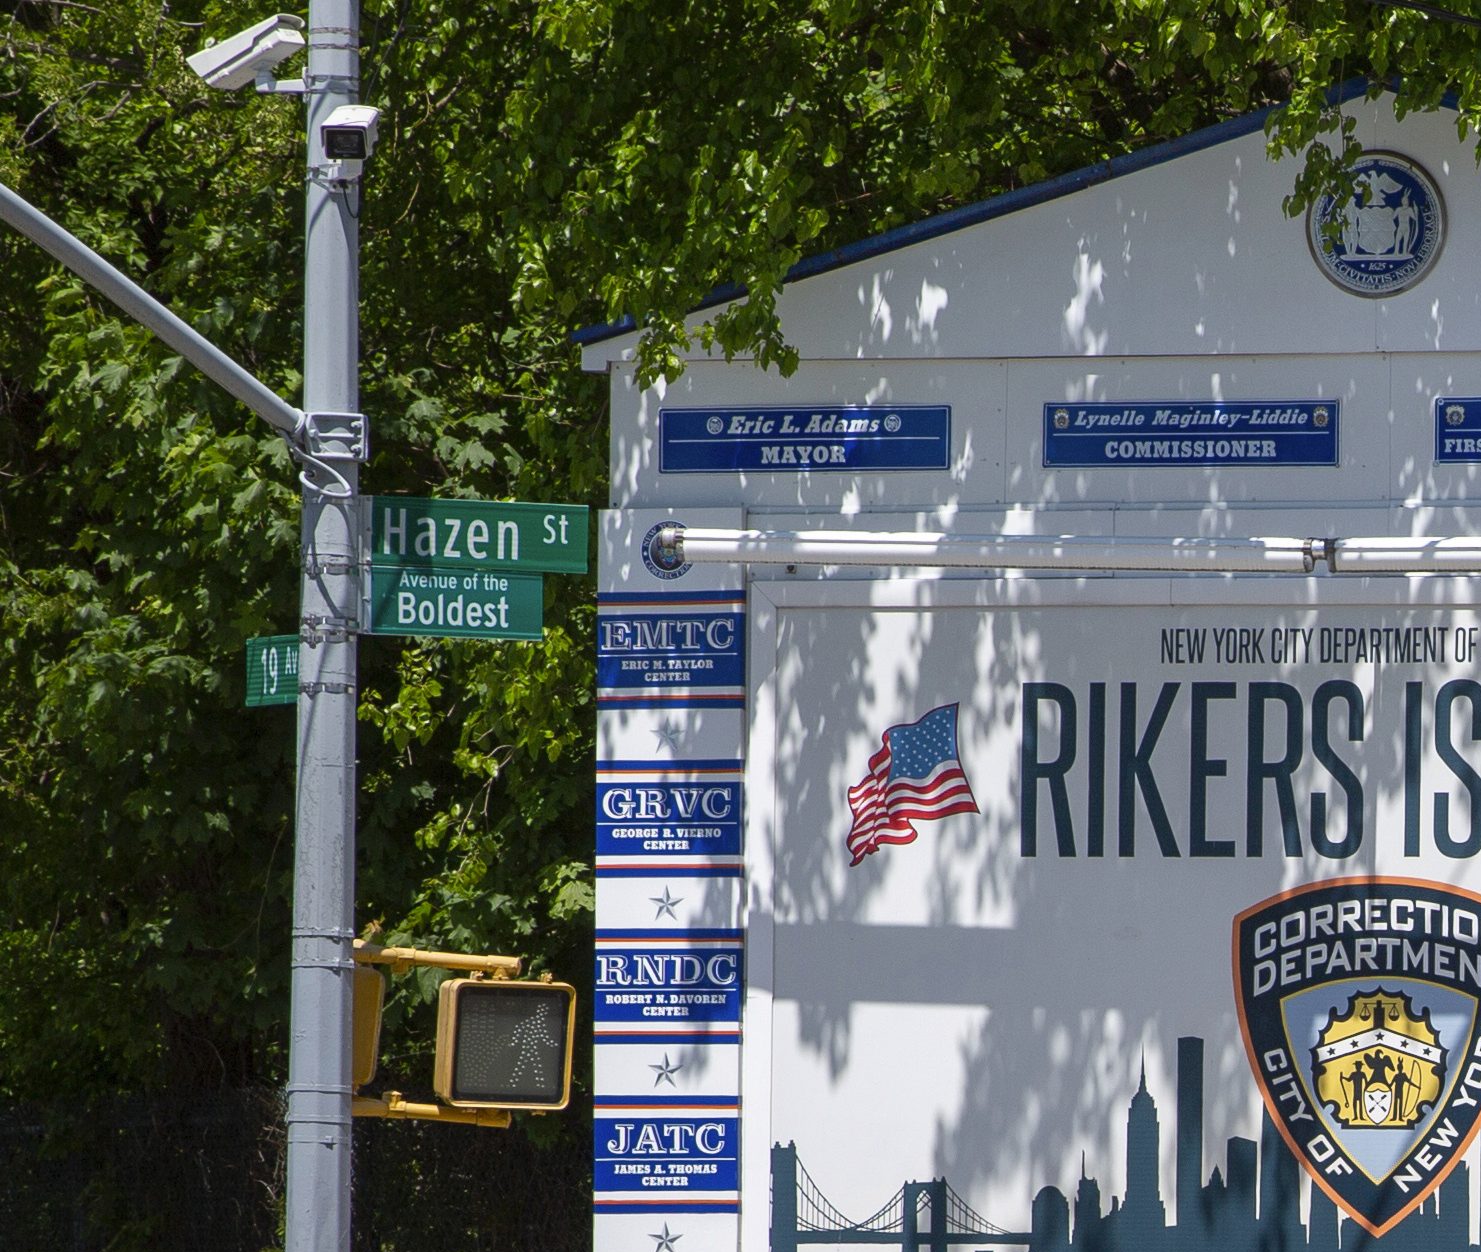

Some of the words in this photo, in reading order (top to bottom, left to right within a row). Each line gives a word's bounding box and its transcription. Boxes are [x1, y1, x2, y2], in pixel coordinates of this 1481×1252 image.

[727, 416, 773, 434] Eric
[780, 416, 800, 433] L.
[805, 414, 880, 433] Adams
[1074, 410, 1145, 429] Lynelle
[1152, 408, 1308, 428] Maginley-Liddie
[761, 445, 846, 464] MAYOR
[1105, 440, 1277, 459] COMMISSIONER
[383, 507, 519, 560] Hazen
[543, 514, 569, 545] St
[400, 570, 457, 590] Avenue
[463, 571, 479, 590] of
[483, 573, 509, 592] the
[397, 592, 510, 629] Boldest
[601, 619, 735, 650] EMTC
[1161, 627, 1207, 664] NEW
[1213, 628, 1266, 664] YORK
[1270, 628, 1314, 664] CITY
[1319, 626, 1448, 664] DEPARTMENT
[1455, 627, 1478, 663] OF
[261, 647, 278, 695] 19
[622, 660, 650, 670] ERIC
[653, 660, 666, 670] M.
[668, 660, 714, 669] TAYLOR
[644, 672, 691, 682] CENTER
[1019, 679, 1365, 860] RIKERS
[602, 788, 732, 819] GRVC
[612, 828, 659, 838] GEORGE
[663, 828, 674, 838] R.
[677, 828, 721, 838] VIERNO
[643, 841, 690, 850] CENTER
[596, 954, 737, 985] RNDC
[606, 994, 653, 1004] ROBERT
[655, 994, 668, 1004] N.
[670, 994, 727, 1004] DAVOREN
[642, 1006, 690, 1017] CENTER
[1263, 1049, 1314, 1124] CITY
[1306, 1133, 1353, 1178] OF
[607, 1123, 725, 1155] JATC
[1392, 1117, 1460, 1193] NEW
[614, 1164, 651, 1174] JAMES
[654, 1164, 666, 1174] A.
[668, 1164, 717, 1174] THOMAS
[642, 1176, 689, 1186] CENTER
